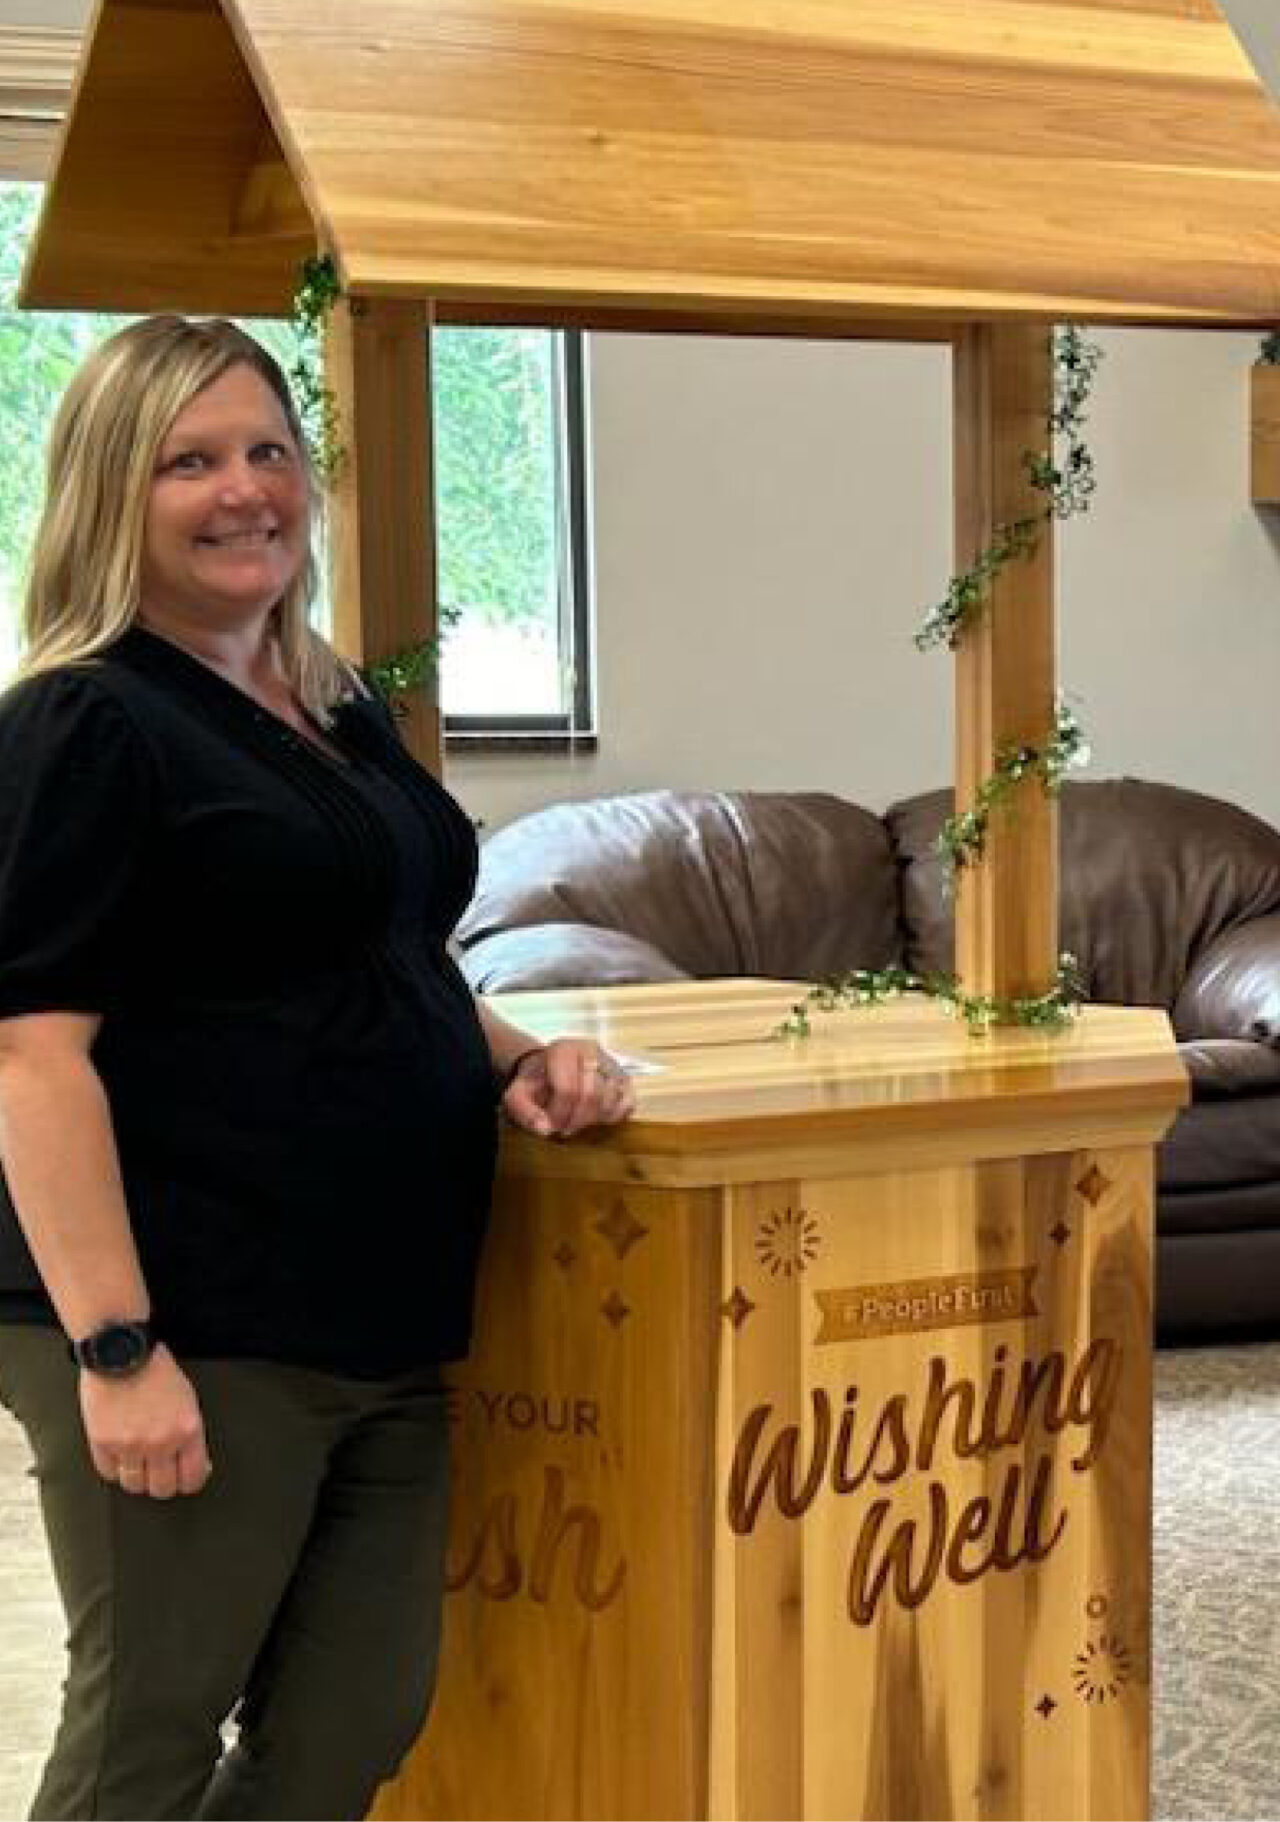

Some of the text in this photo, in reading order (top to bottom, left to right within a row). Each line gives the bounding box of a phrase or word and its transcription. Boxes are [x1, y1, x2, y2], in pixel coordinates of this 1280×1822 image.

[475, 1390, 599, 1437] YOUR
[727, 1337, 1123, 1536] Wishing
[848, 1454, 1068, 1628] Well
